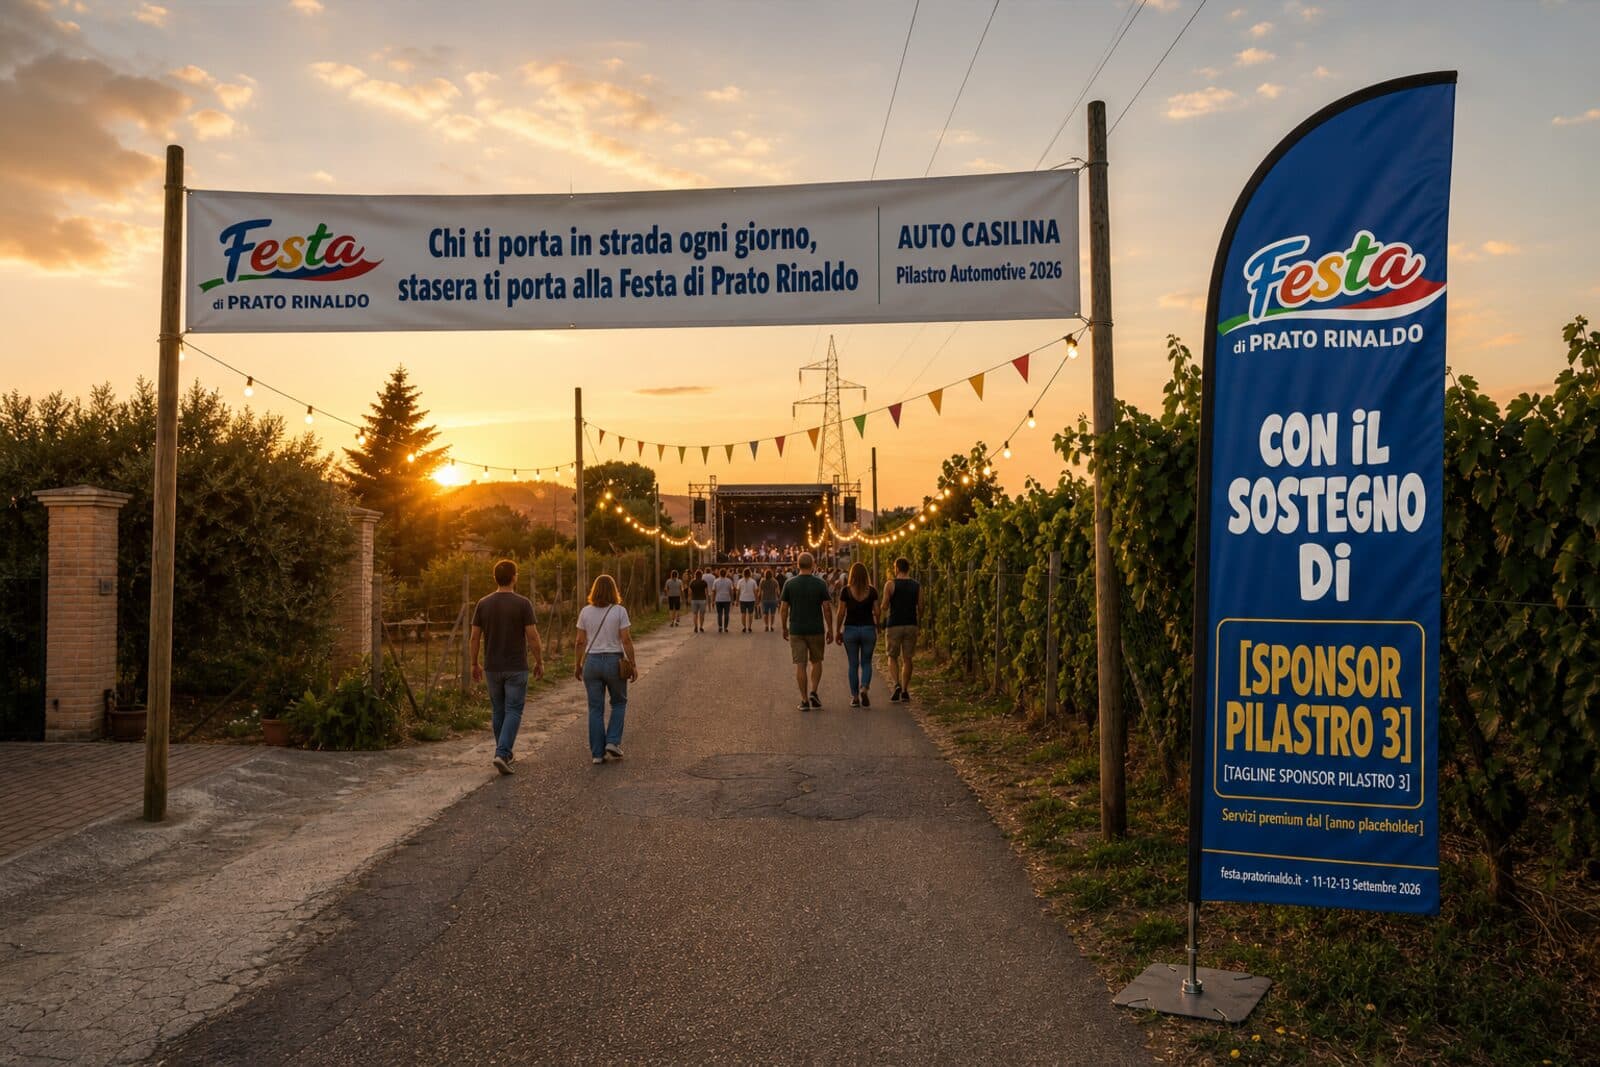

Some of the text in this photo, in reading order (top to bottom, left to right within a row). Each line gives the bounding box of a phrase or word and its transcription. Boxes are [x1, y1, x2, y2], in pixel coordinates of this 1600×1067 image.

[219, 218, 366, 283] Festa
[429, 221, 817, 264] Chi ti porta in strada ogni giorno,
[898, 219, 1060, 250] AUTO CASILINA
[398, 260, 859, 307] stasera ti porta alla Festa di Prato Rinaldo
[896, 261, 1063, 285] Pilastro Automotive 2026
[1244, 230, 1426, 324] Festa
[213, 294, 370, 310] di PRATO RINALDO
[1233, 323, 1424, 354] di PRATO RINALDO
[1259, 411, 1338, 468] CON
[1227, 472, 1427, 535] SOSTEGNO
[1239, 640, 1402, 698] [SPONSOR
[1226, 701, 1412, 763] PILASTRO 3]
[1224, 765, 1410, 792] [TAGLINE SPONSOR PILASTRO 3]
[1222, 808, 1424, 837] Servizi premium dal [anno placeholder]
[1221, 866, 1301, 886] festa.pratorinaldo.it
[1312, 875, 1350, 889] 11-12-13
[1352, 879, 1397, 893] Settembre
[1399, 882, 1421, 896] 2026
